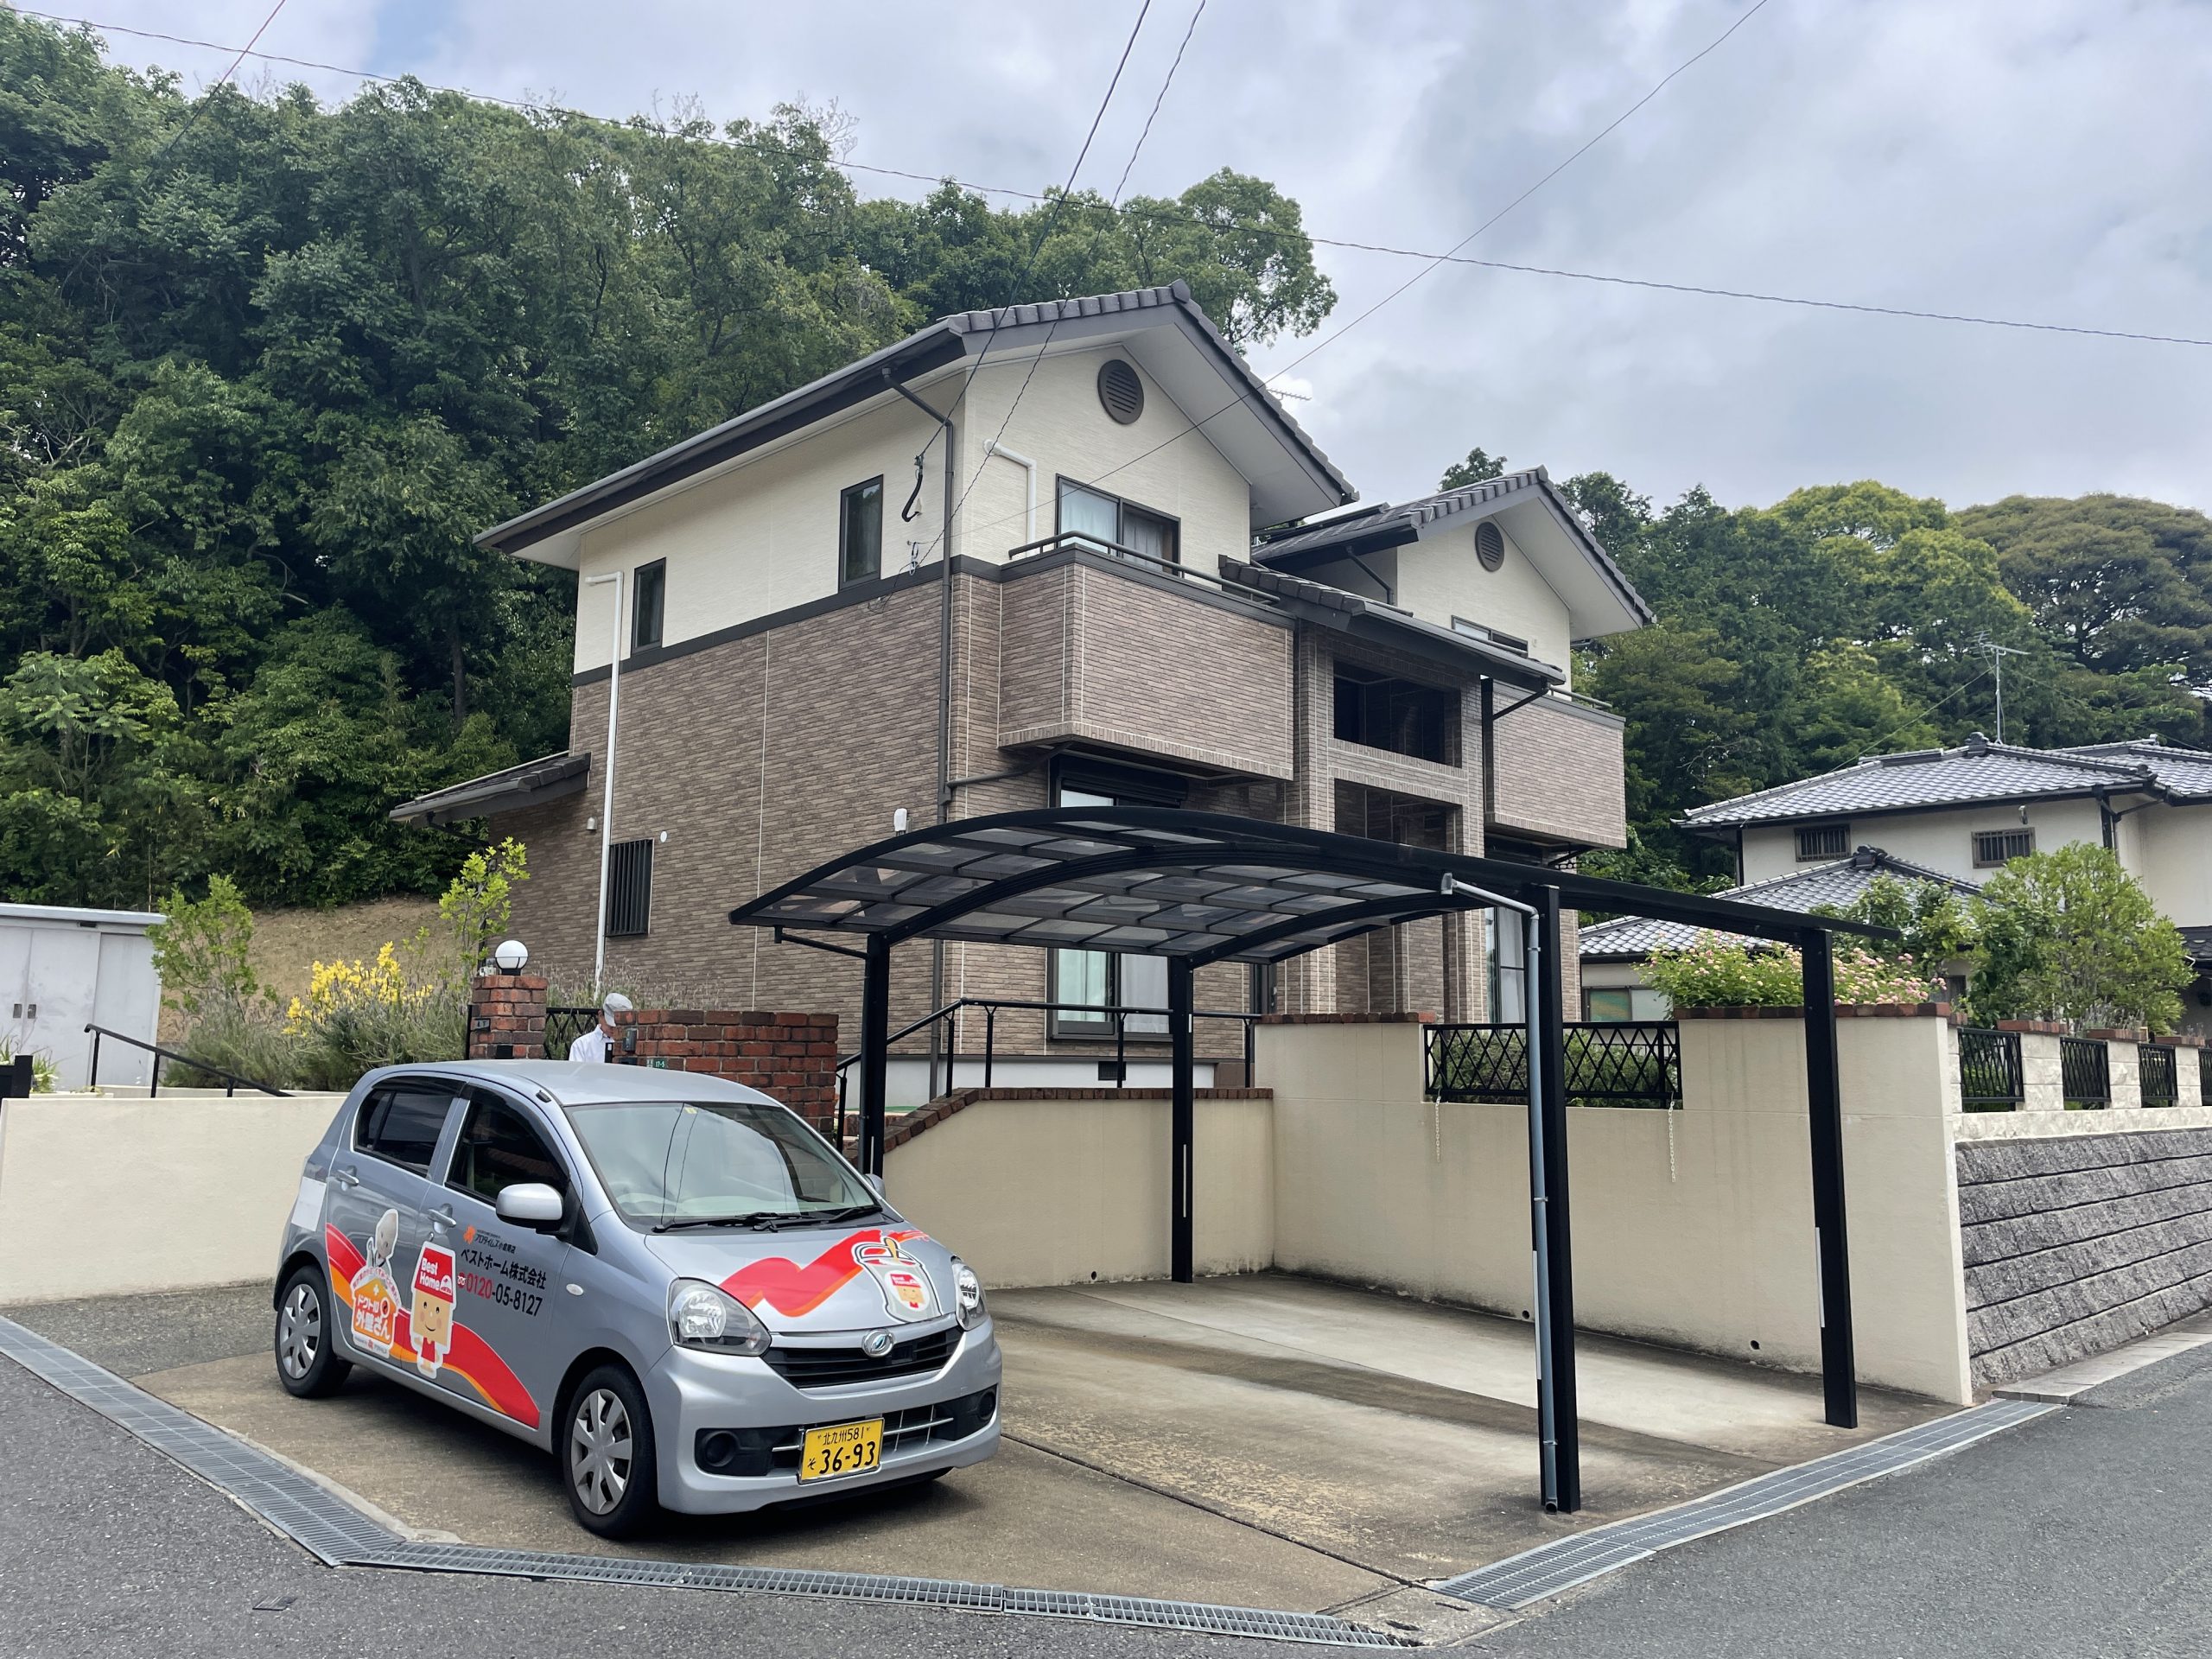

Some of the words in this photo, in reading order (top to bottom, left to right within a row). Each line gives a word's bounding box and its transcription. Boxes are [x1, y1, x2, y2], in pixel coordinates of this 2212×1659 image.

[419, 1271, 441, 1291] Home
[421, 1257, 438, 1275] Best
[461, 1249, 547, 1290] ベストホーム株式会社
[467, 1272, 543, 1317] 0120-05-8127
[355, 1308, 391, 1341] 外壁さん
[818, 1440, 876, 1474] 36-93
